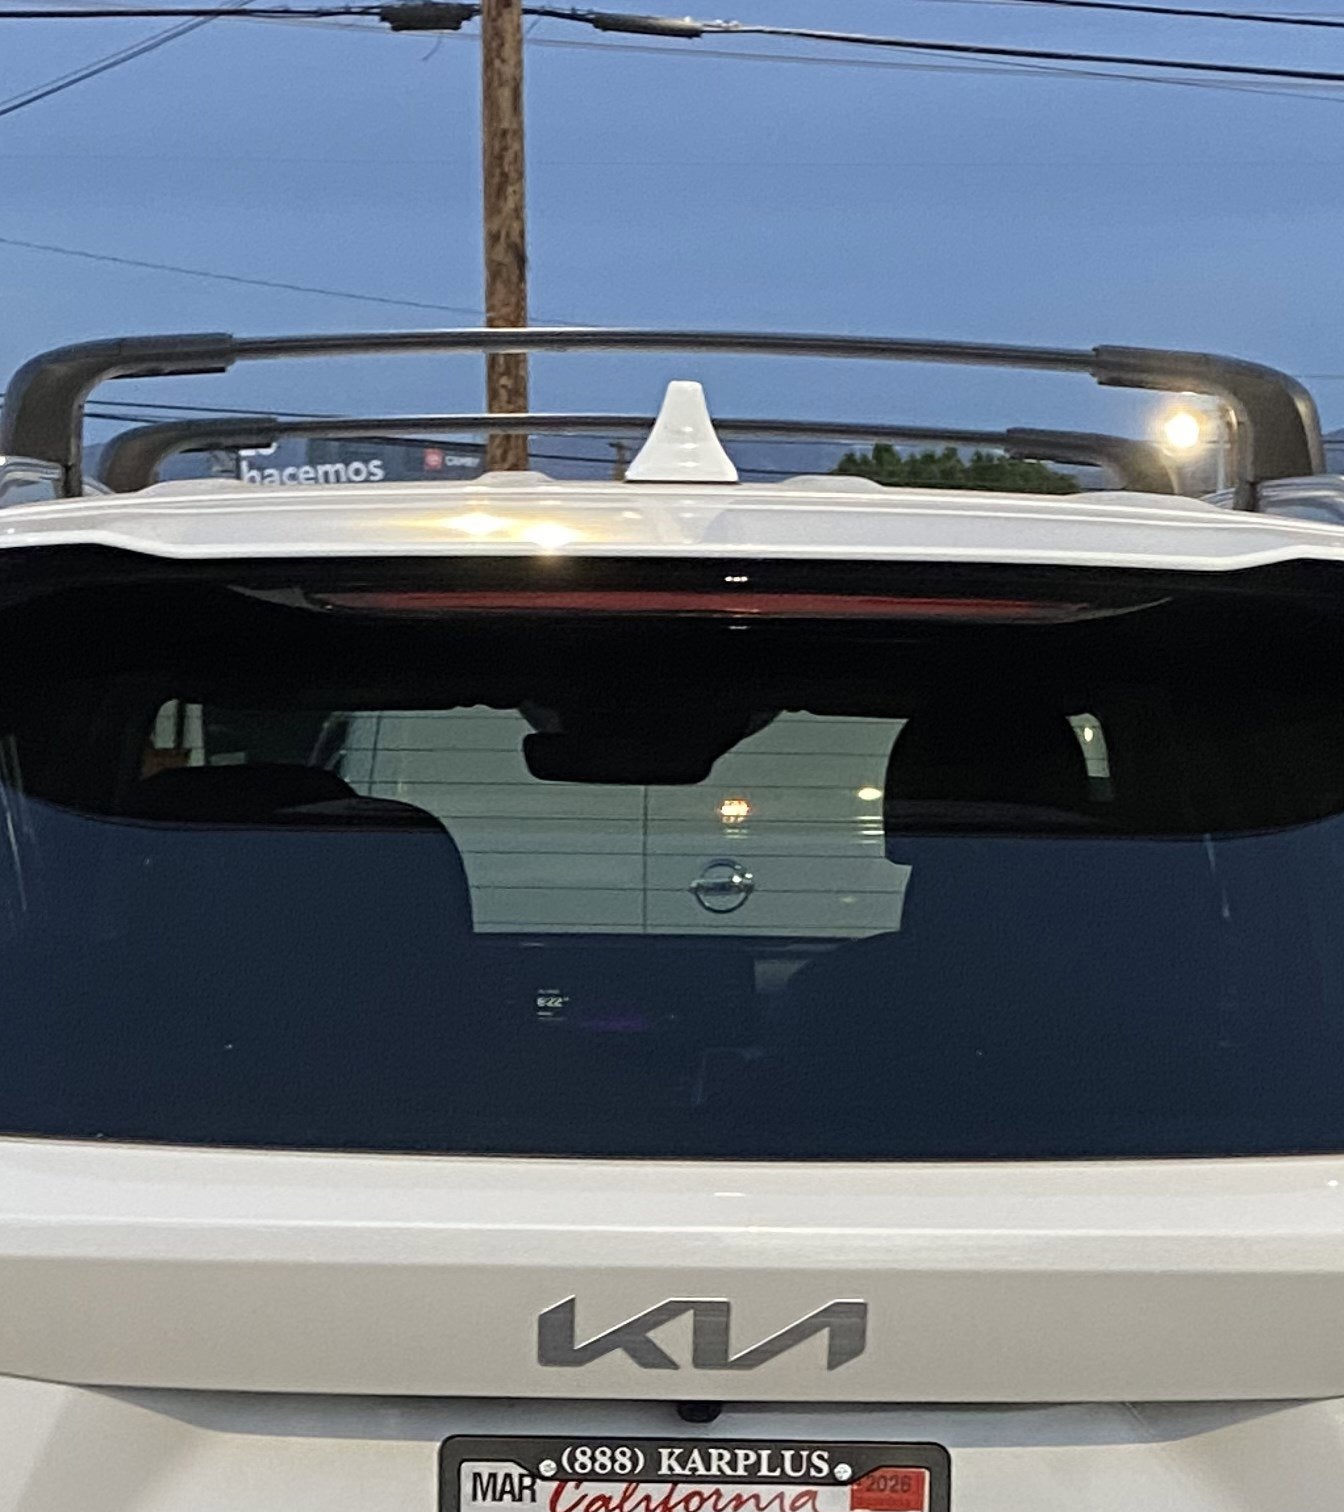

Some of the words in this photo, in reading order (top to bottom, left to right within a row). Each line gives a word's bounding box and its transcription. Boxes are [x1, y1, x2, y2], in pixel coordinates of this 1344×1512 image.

[239, 458, 386, 485] hacemos
[561, 1446, 645, 1475] (888)
[658, 1448, 830, 1478] KARPLUS
[471, 1472, 537, 1503] MAR
